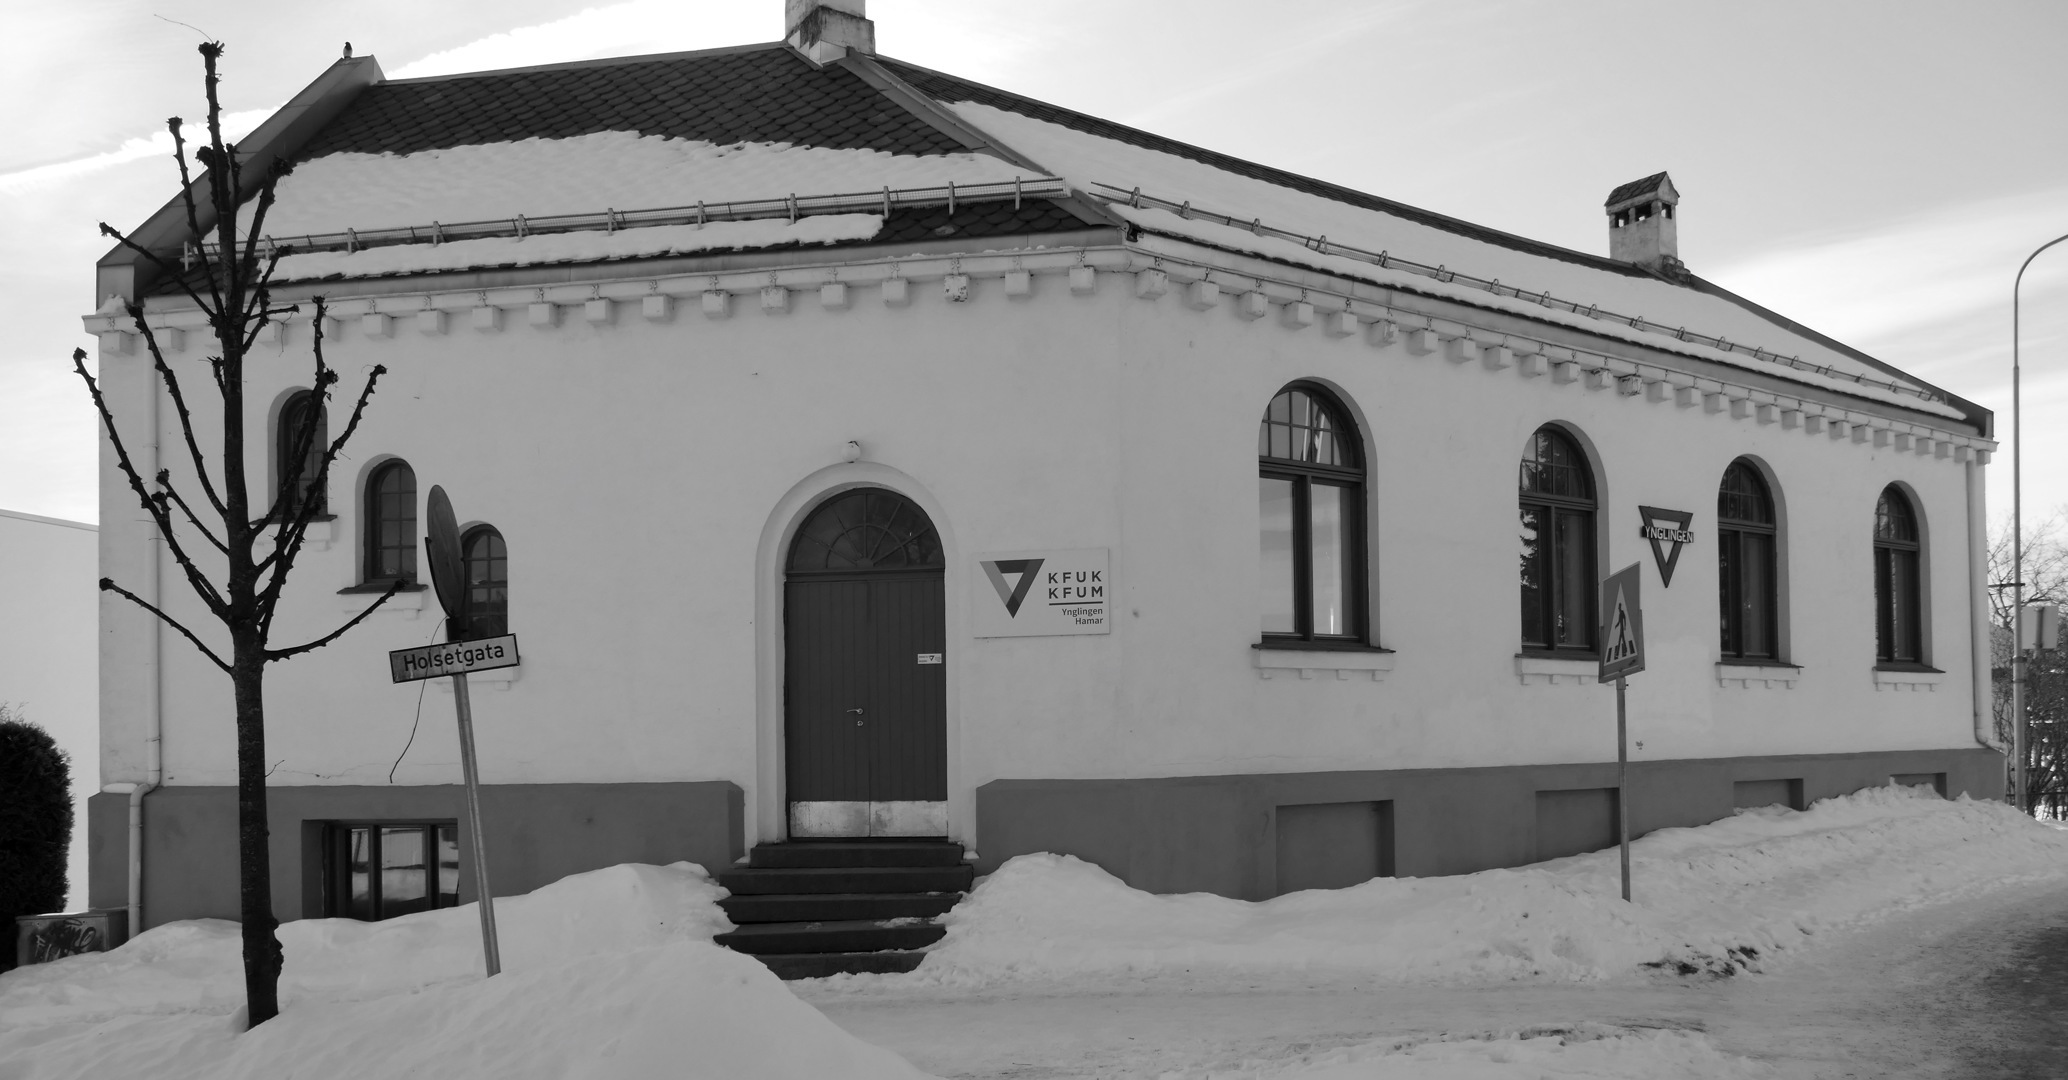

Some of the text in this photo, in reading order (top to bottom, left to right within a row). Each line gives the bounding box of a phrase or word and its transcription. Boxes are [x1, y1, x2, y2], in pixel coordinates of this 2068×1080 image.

[1645, 526, 1693, 543] YNGLINGEN
[1048, 570, 1102, 584] KFUK
[1048, 586, 1103, 599] KFUM
[1062, 607, 1103, 617] Ynglingen
[1075, 617, 1103, 625] Hamar
[403, 643, 504, 671] Holsetgata
